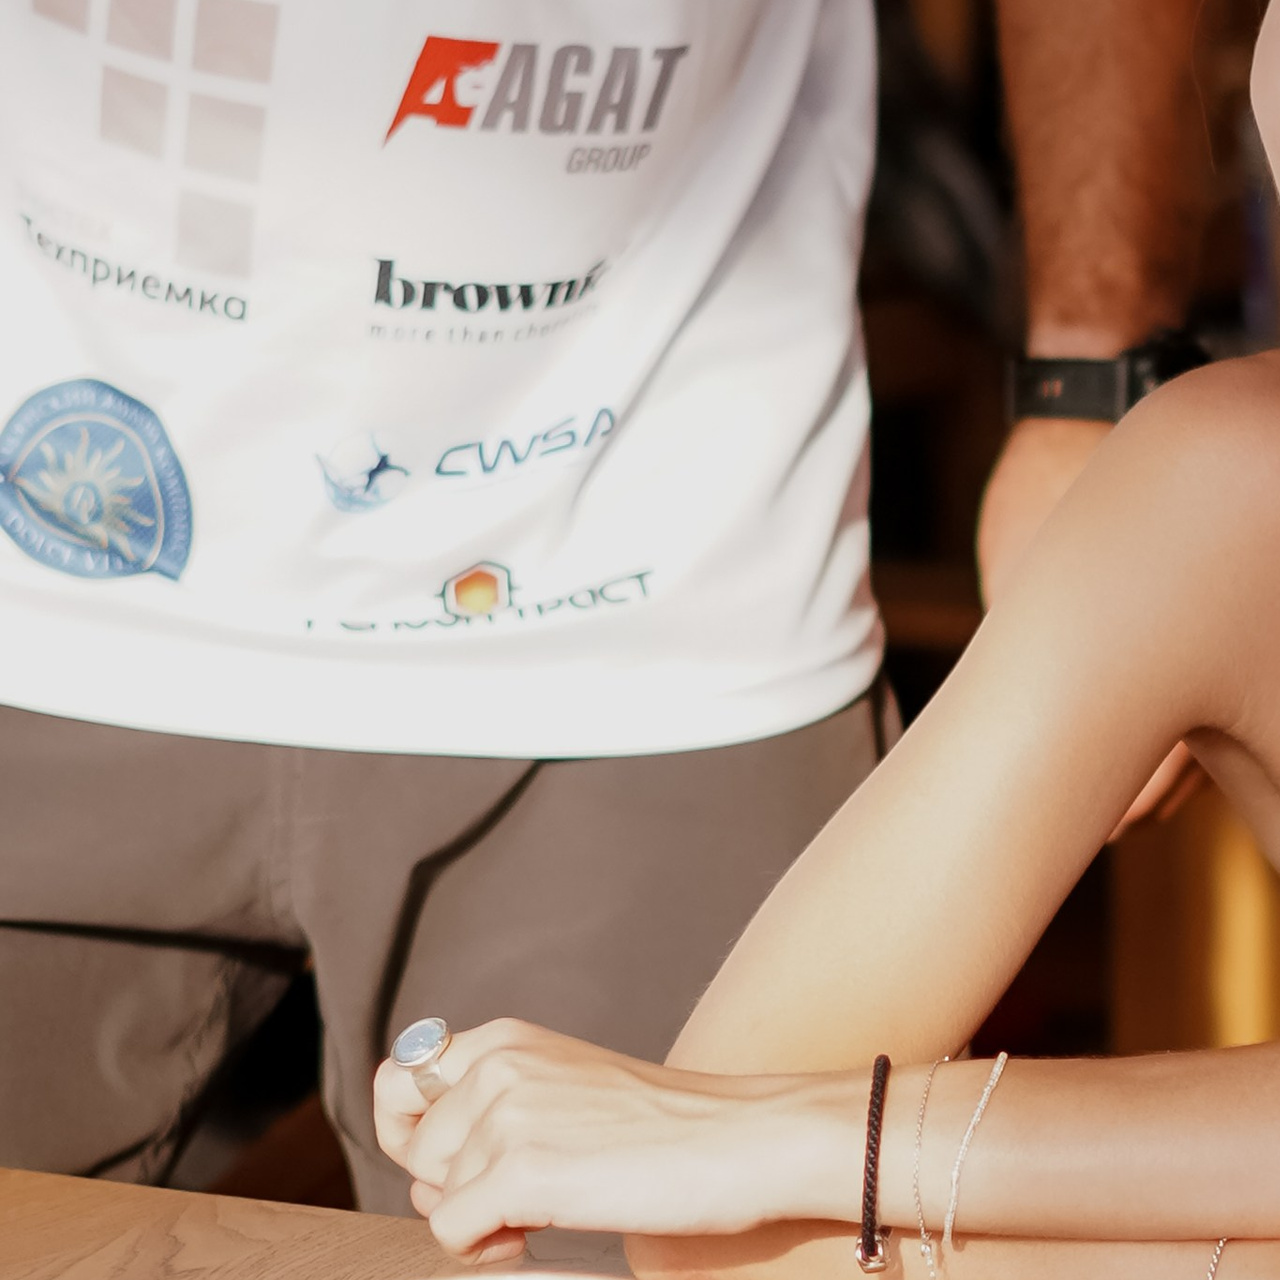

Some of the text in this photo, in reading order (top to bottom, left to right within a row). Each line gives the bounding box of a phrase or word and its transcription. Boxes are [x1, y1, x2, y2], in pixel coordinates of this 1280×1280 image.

[479, 42, 691, 135] AGAT
[565, 143, 653, 175] GROUP
[434, 407, 615, 476] CWSA
